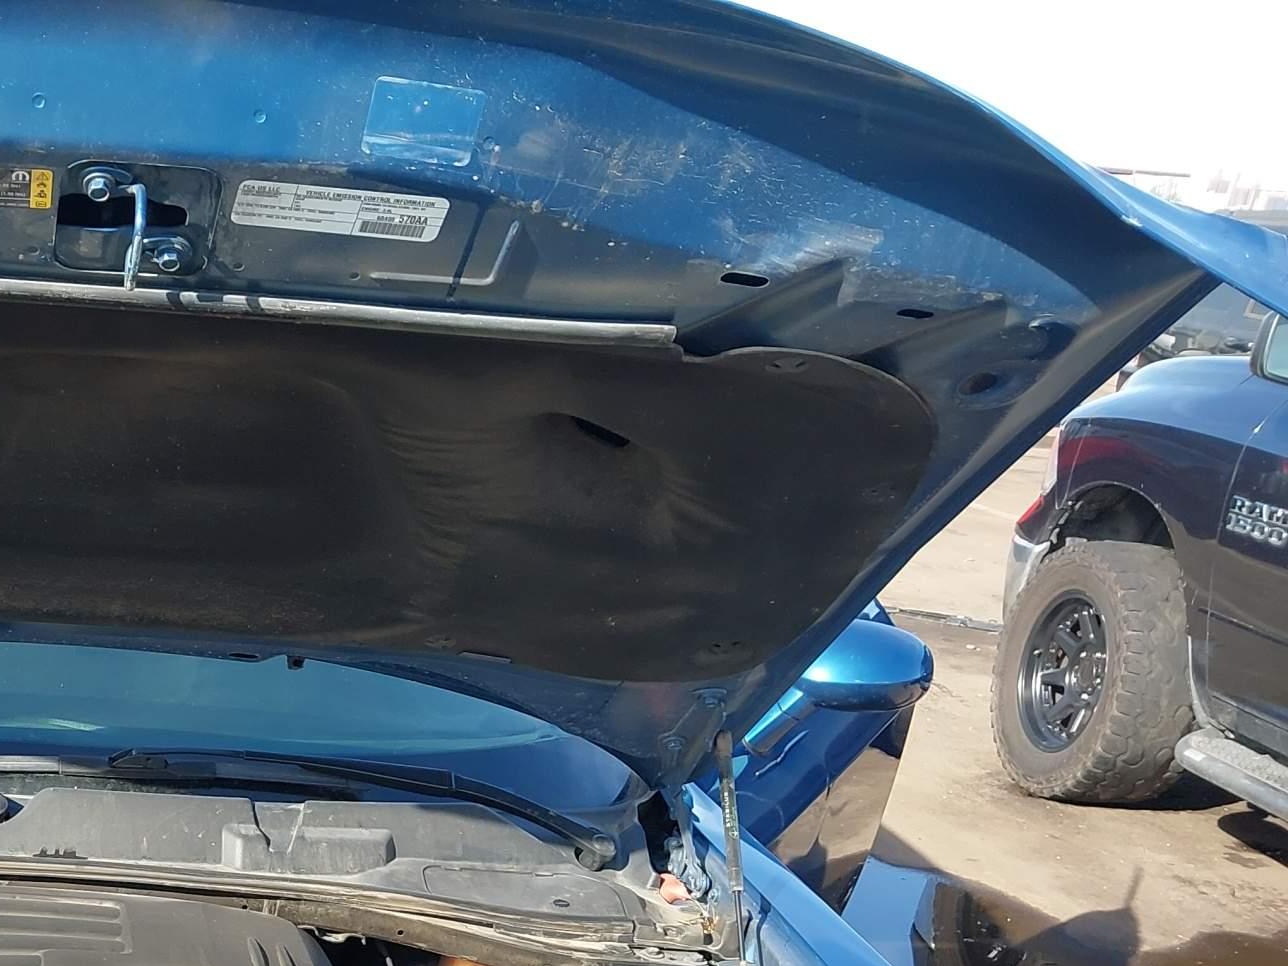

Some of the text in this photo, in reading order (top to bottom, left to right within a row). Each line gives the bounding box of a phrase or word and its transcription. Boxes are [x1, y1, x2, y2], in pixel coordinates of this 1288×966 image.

[305, 190, 332, 198] VEHICLE
[332, 192, 362, 201] EMISSION
[363, 196, 392, 204] CONTROL
[392, 199, 437, 208] INFORMATION
[399, 214, 429, 226] 570AA
[1228, 495, 1288, 527] RAM
